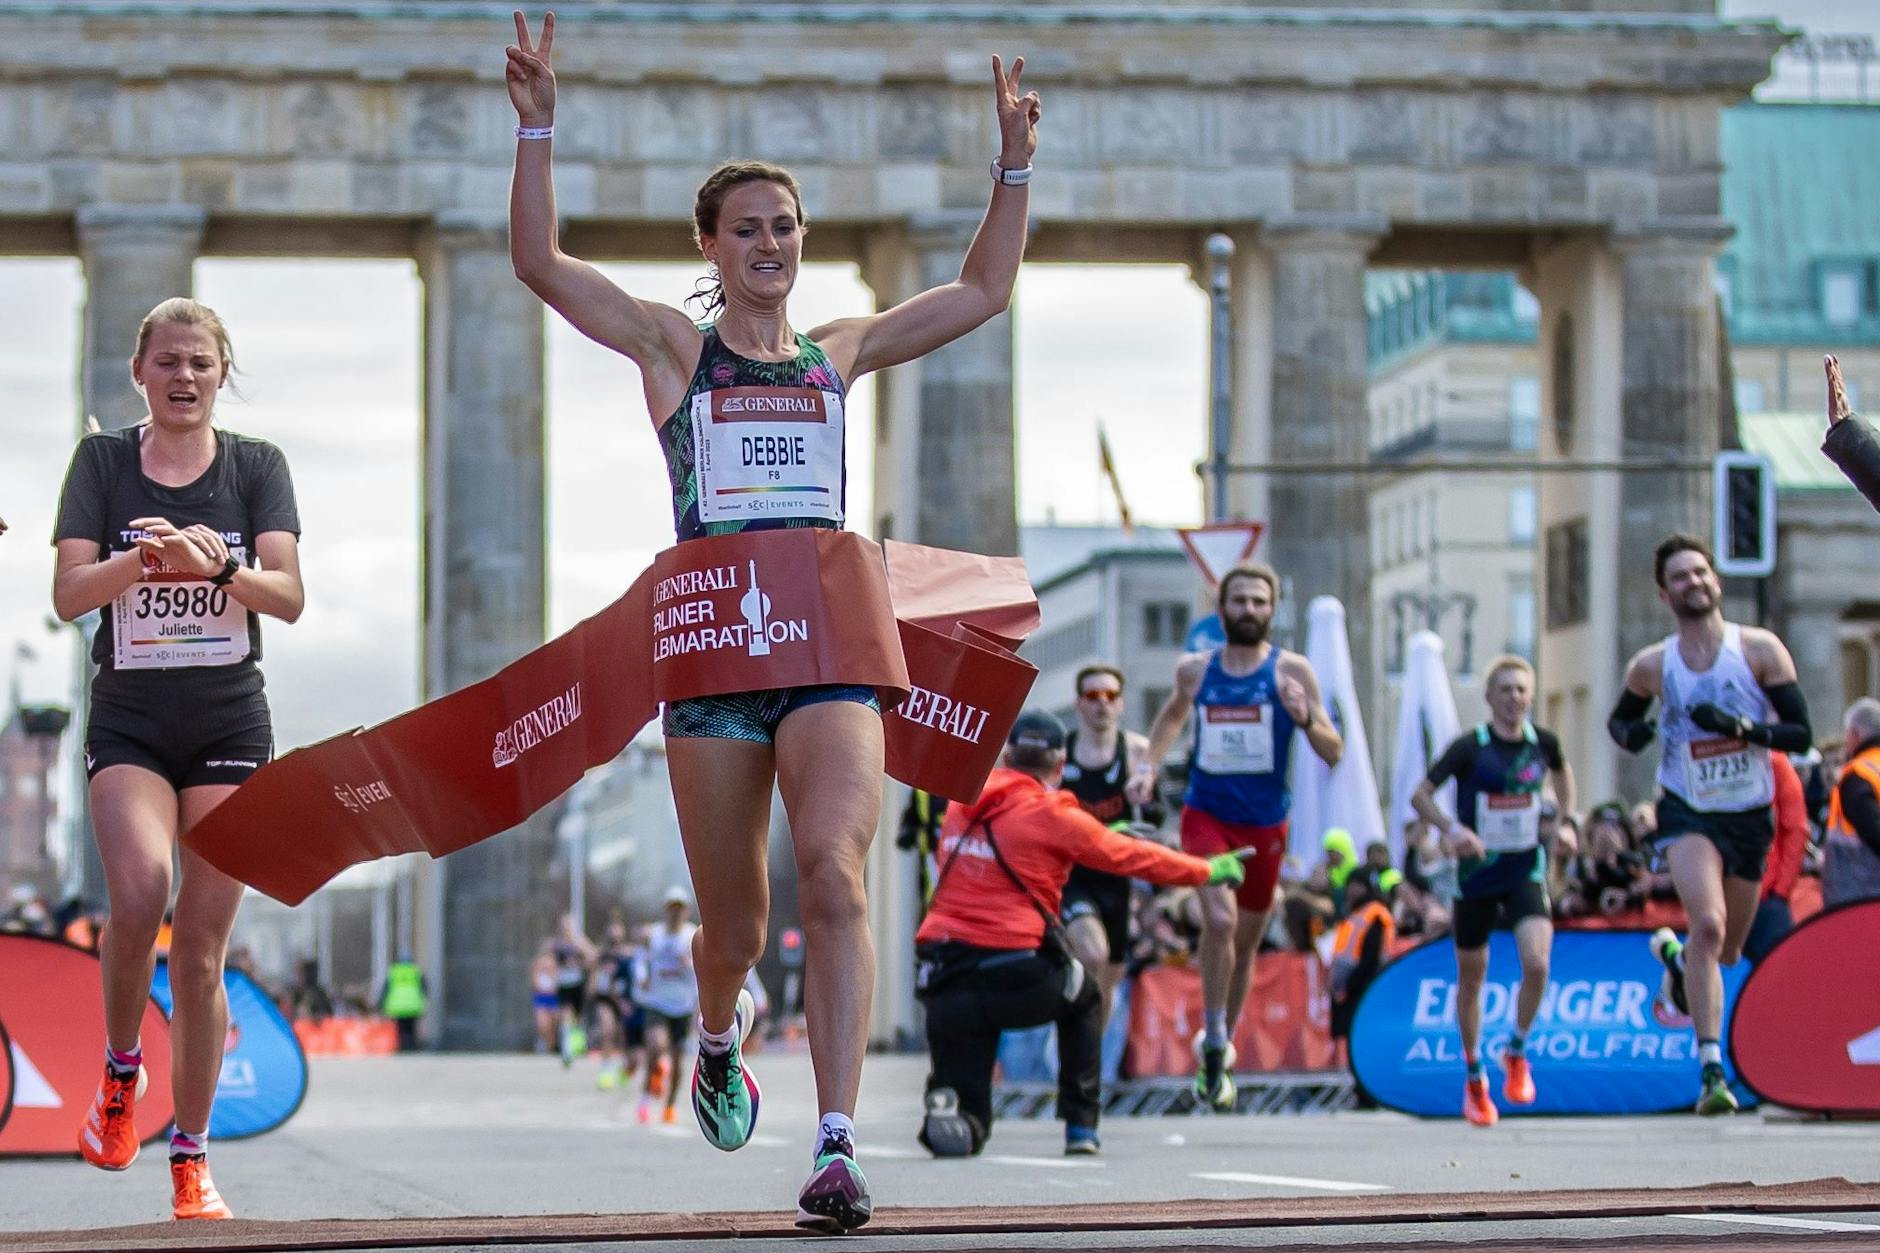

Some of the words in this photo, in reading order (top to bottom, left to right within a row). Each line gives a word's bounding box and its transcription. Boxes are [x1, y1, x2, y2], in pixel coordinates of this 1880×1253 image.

[745, 397, 816, 412] GENERALI
[742, 436, 806, 466] DEBBIE
[768, 470, 781, 480] F8
[655, 566, 738, 604] GENERALI
[135, 586, 228, 619] 35980
[654, 600, 715, 636] RLINER
[158, 623, 203, 636] Juliette
[514, 681, 582, 753] GENERALI
[897, 685, 991, 745] ERALI
